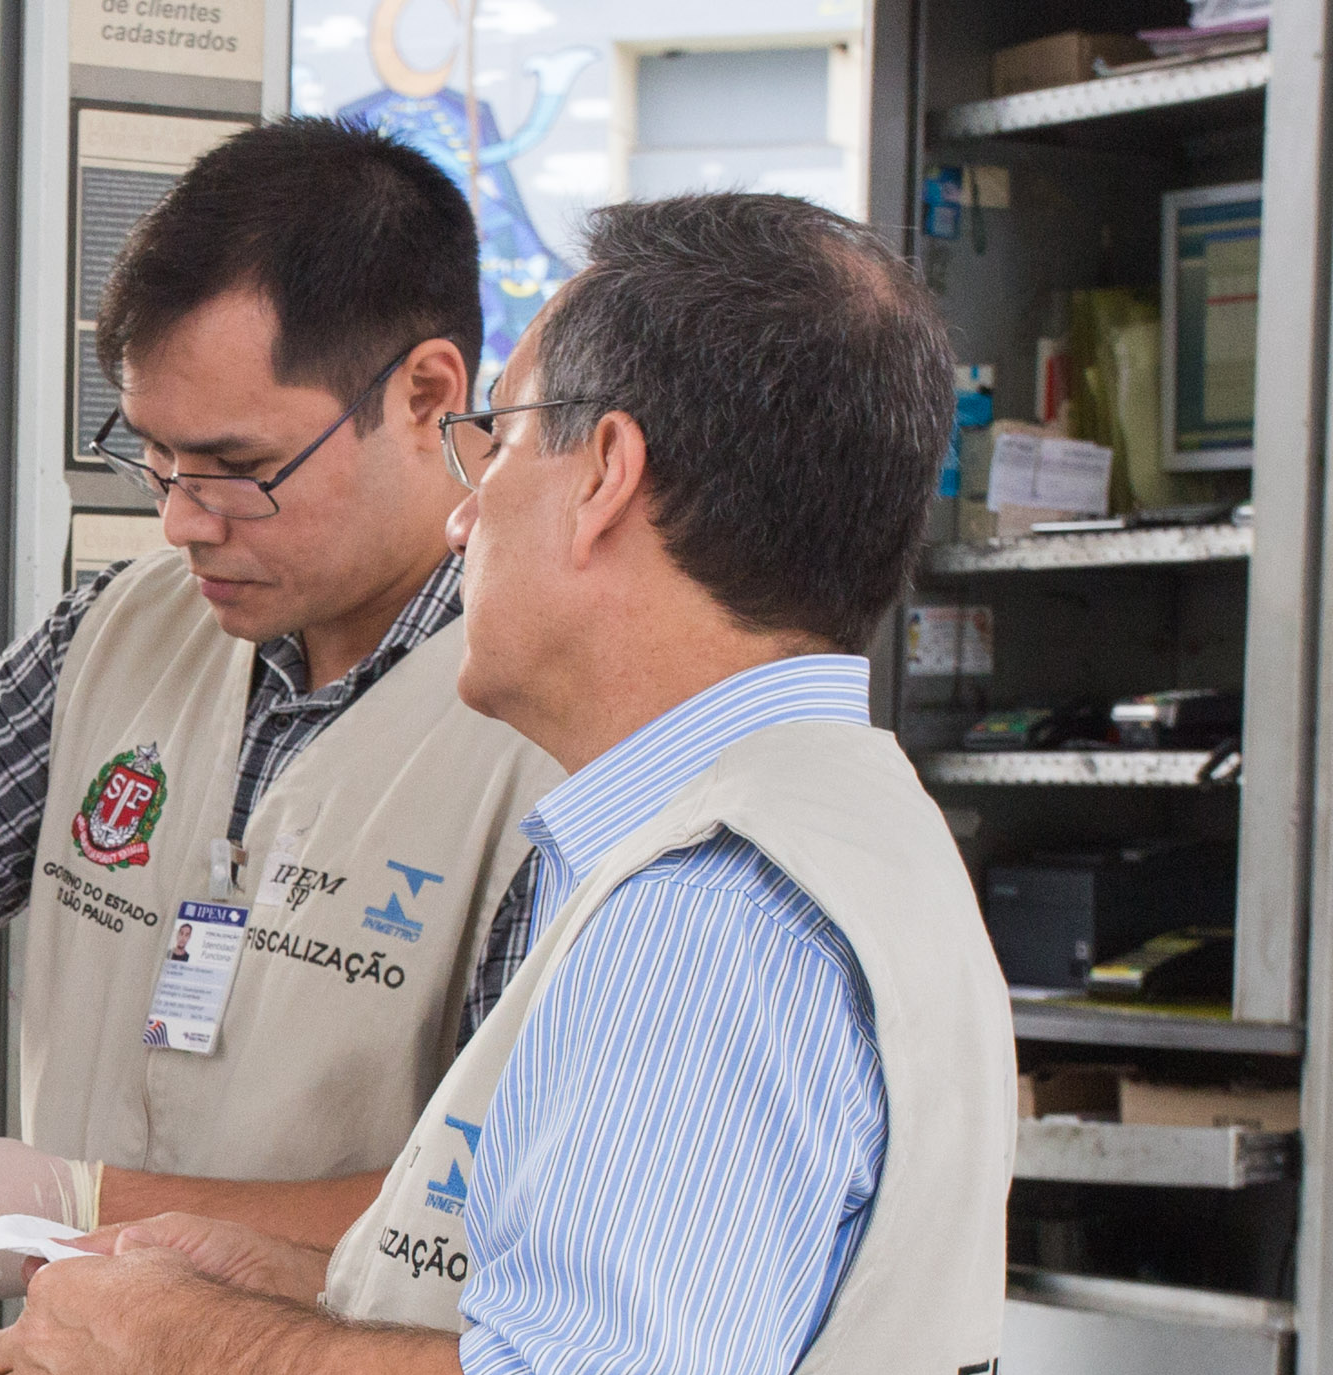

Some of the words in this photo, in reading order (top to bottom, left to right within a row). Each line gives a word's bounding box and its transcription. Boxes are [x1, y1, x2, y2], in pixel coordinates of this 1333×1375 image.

[135, 0, 222, 24] clientes
[101, 23, 239, 53] cadastrados
[270, 864, 347, 895] IPEM
[81, 903, 124, 933] PAULO
[83, 882, 103, 901] DO
[104, 892, 158, 927] ESTADO
[196, 905, 228, 921] IPEM
[362, 916, 421, 943] INMETRO
[245, 927, 405, 989] FISCALIZAÇÃO
[424, 1192, 465, 1219] INMET
